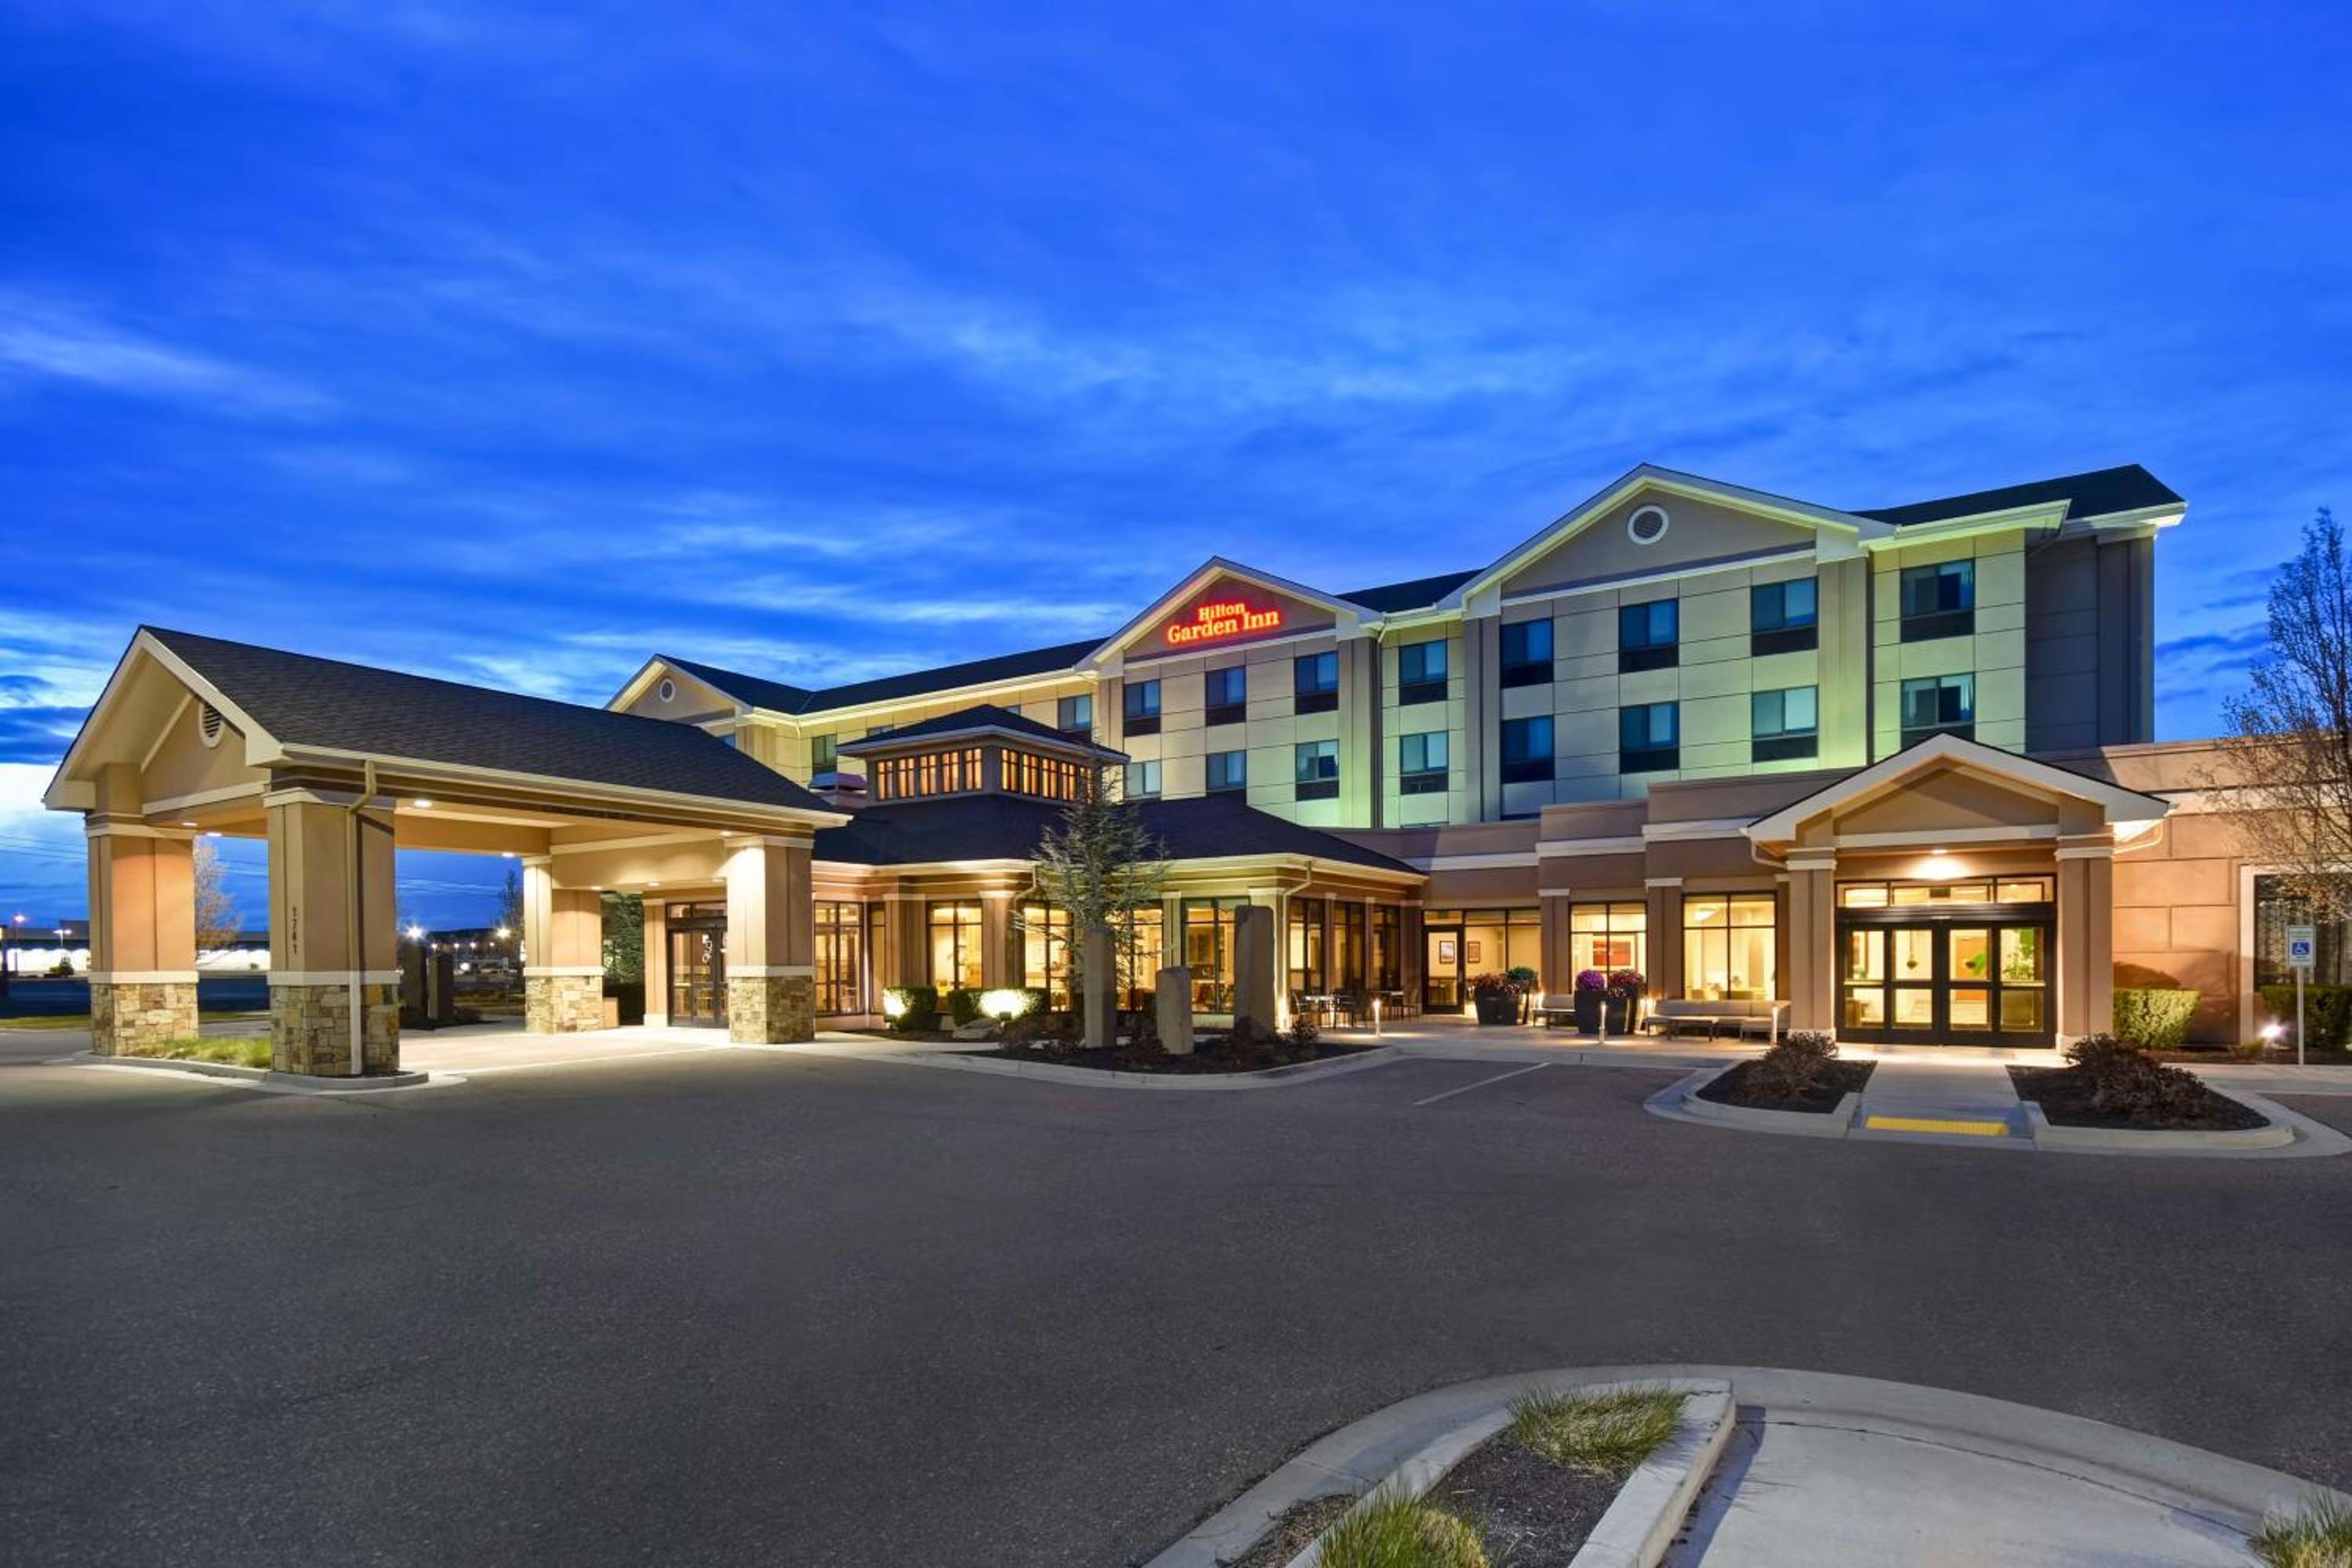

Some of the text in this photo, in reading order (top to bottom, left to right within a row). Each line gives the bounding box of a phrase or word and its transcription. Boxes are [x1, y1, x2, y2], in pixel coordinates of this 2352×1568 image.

[1199, 602, 1246, 622] Hilton
[1167, 610, 1280, 644] Garden Inn
